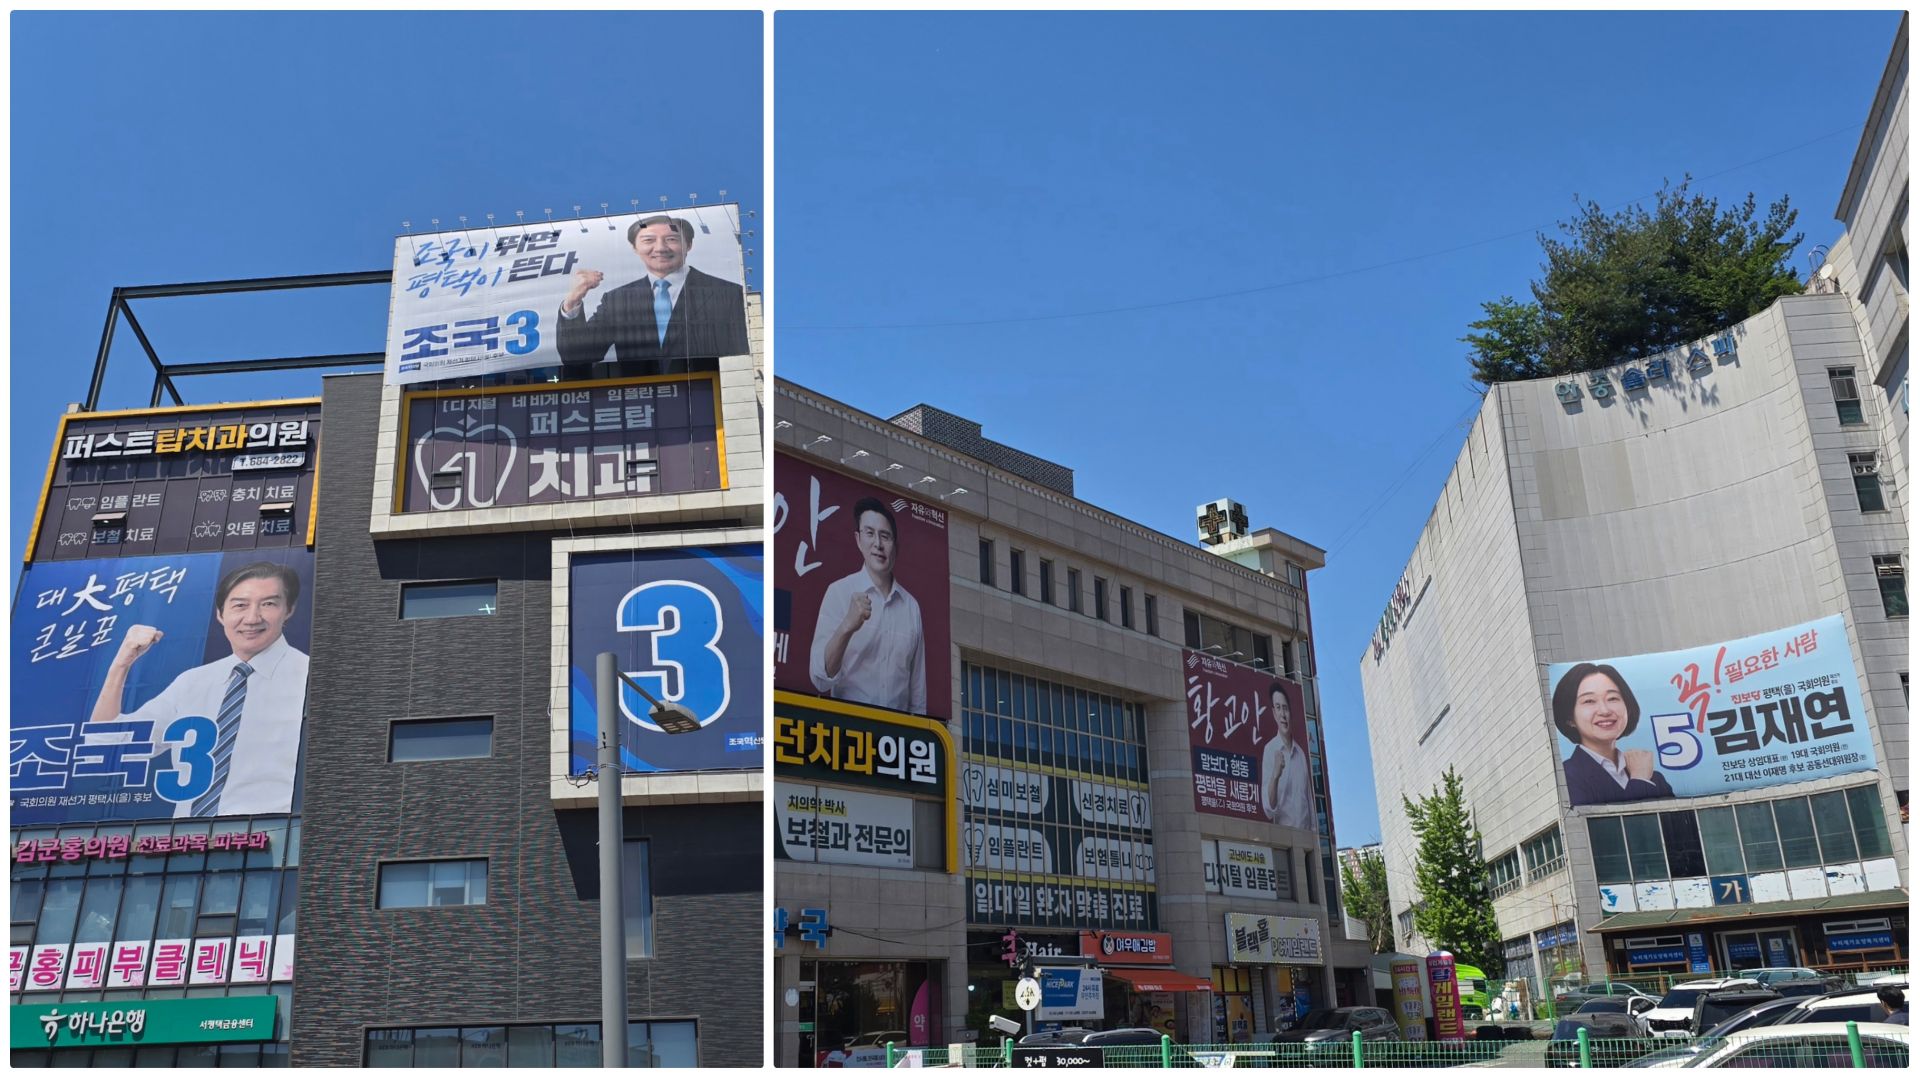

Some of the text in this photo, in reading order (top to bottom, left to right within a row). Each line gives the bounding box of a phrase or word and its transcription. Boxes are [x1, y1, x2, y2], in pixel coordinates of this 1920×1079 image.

[414, 230, 562, 272] 조국이 뛰면
[405, 251, 579, 298] 평택이 뜬다
[400, 310, 540, 361] 조국 3
[511, 391, 590, 409] 네비게이션
[530, 404, 654, 435] 퍼스트탑
[63, 420, 309, 459] 퍼스트탑치과의원
[529, 442, 652, 498] 치과
[100, 493, 161, 510] 임플란트
[232, 485, 294, 502] 충치 치료
[92, 528, 154, 544] 보철 치료
[227, 518, 290, 536] 잇몸 치료
[31, 615, 118, 663] 큰일꾼
[616, 579, 731, 735] 3
[1670, 629, 1818, 734] 꼭! 필요한 사람
[1731, 689, 1761, 705] 진보당
[1762, 682, 1796, 700] 평택(을)
[1797, 675, 1831, 692] 국회의원
[1187, 675, 1267, 745] 황교안
[1650, 687, 1854, 771] 5 김재연
[10, 716, 219, 803] 조국 3
[1200, 752, 1250, 778] 말보다 행동
[1721, 760, 1746, 771] 진보당
[1791, 748, 1809, 759] 19대
[1724, 771, 1744, 783] 21대
[1745, 770, 1762, 781] 대선
[1763, 765, 1787, 777] 이재명
[1789, 763, 1806, 774] 후보
[20, 795, 57, 808] 국회의원
[58, 794, 86, 806] 재선거
[88, 792, 131, 805] 평택시(을)
[133, 791, 153, 803] 후보
[986, 778, 1041, 803] 심미보철
[1195, 773, 1260, 803] 평택을 새롭게
[788, 794, 846, 815] 치의학 박사
[1082, 792, 1129, 816] 신경치료
[16, 831, 270, 863] 김군홍의원 진료과목 피부과
[786, 817, 911, 856] 보철과 전문의
[988, 836, 1043, 860] 임플란트
[1084, 847, 1132, 869] 보험틀니
[1204, 862, 1243, 888] 디지털
[975, 883, 1145, 922] 일대일 환자 맞춤 진료
[1026, 942, 1062, 957] Hair
[1234, 918, 1270, 954] 블랙홀
[68, 1009, 254, 1037] 하나은행 서평택금융센터
